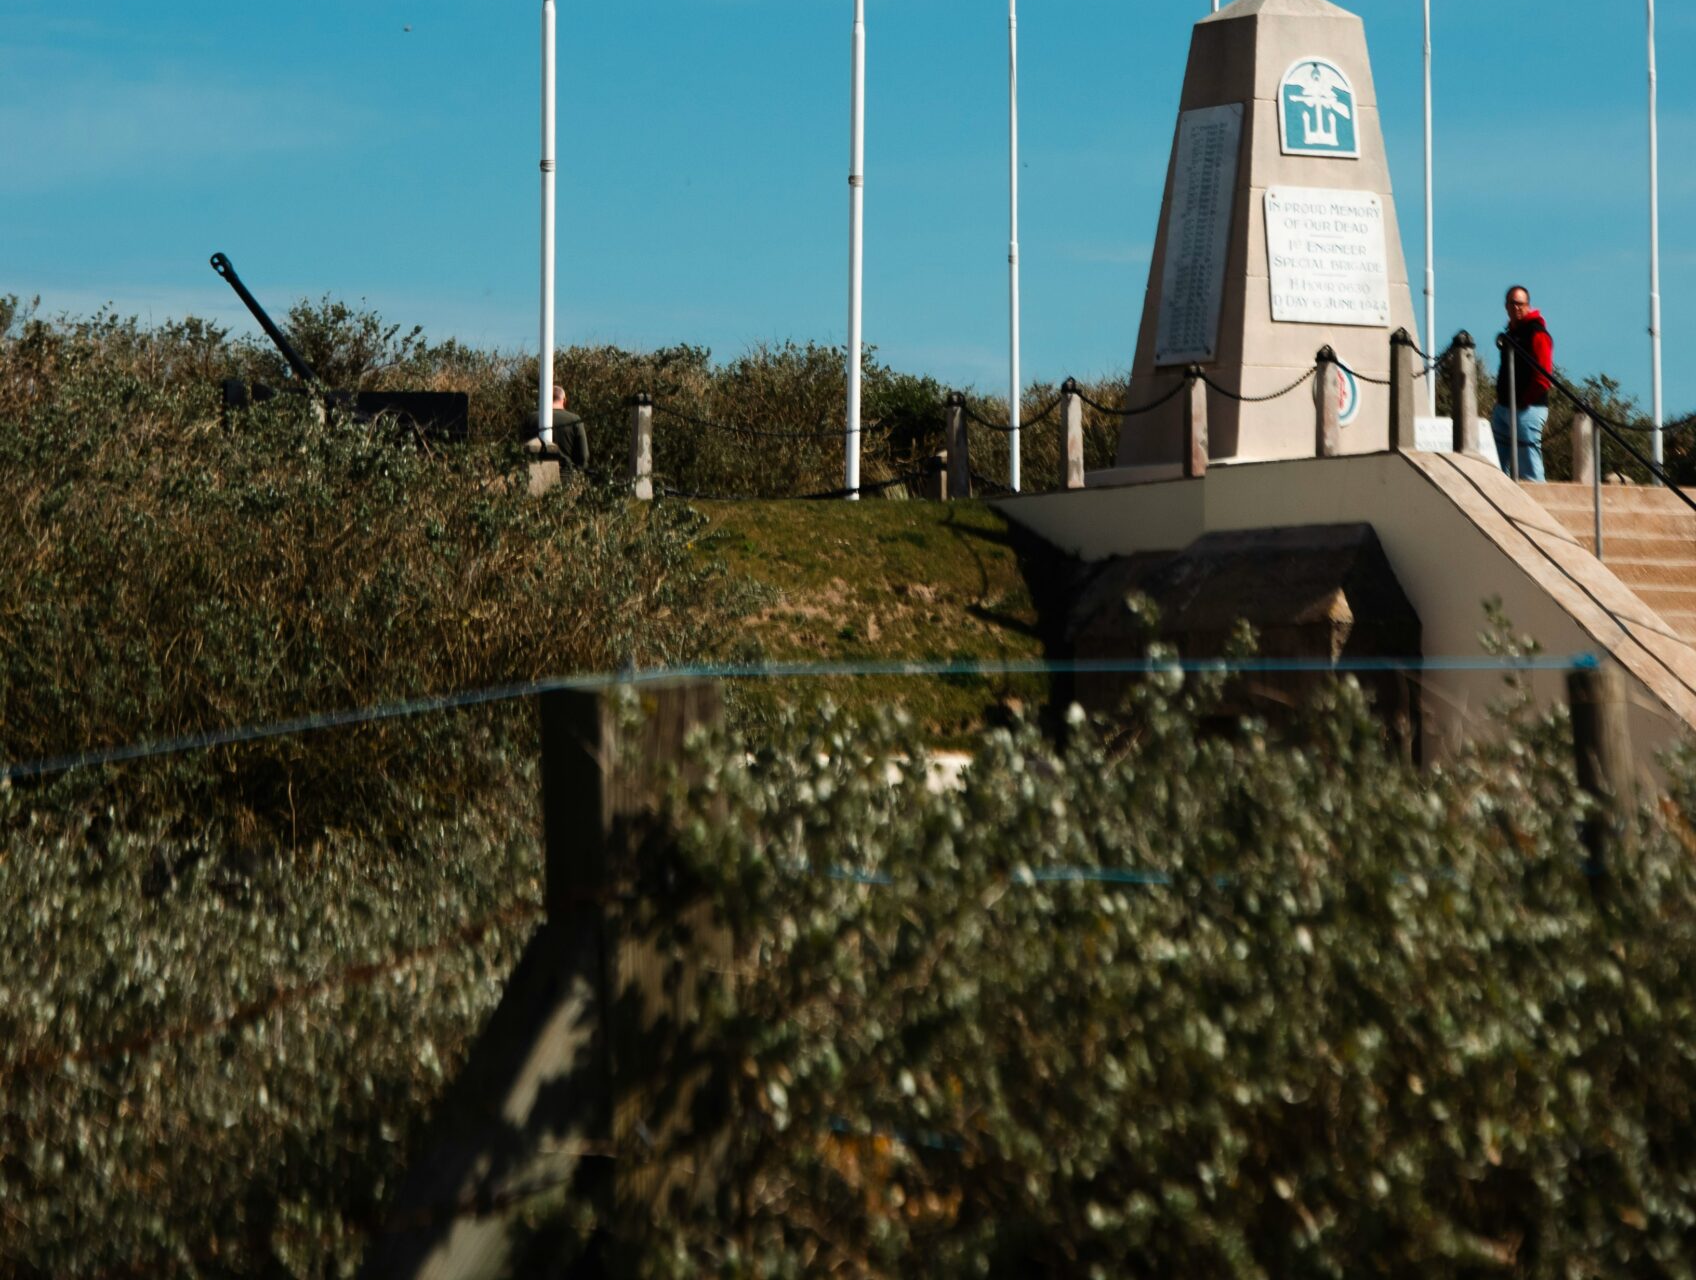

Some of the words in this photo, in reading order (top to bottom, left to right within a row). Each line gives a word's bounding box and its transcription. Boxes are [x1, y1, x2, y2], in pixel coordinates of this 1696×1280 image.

[1269, 200, 1281, 212] IN
[1285, 202, 1327, 215] PROUD
[1331, 204, 1379, 217] MEMORY
[1284, 217, 1300, 229] OF
[1304, 219, 1330, 232] OUR
[1334, 220, 1369, 234] DEAD
[1306, 241, 1367, 256] ENGINEER
[1274, 256, 1323, 269] SPECIAL
[1331, 260, 1382, 272] BRIGADE
[1302, 279, 1335, 292] HOUR
[1273, 295, 1282, 307] D
[1286, 295, 1309, 308] DAY
[1326, 297, 1356, 310] JUNE
[1360, 299, 1388, 312] 1944
